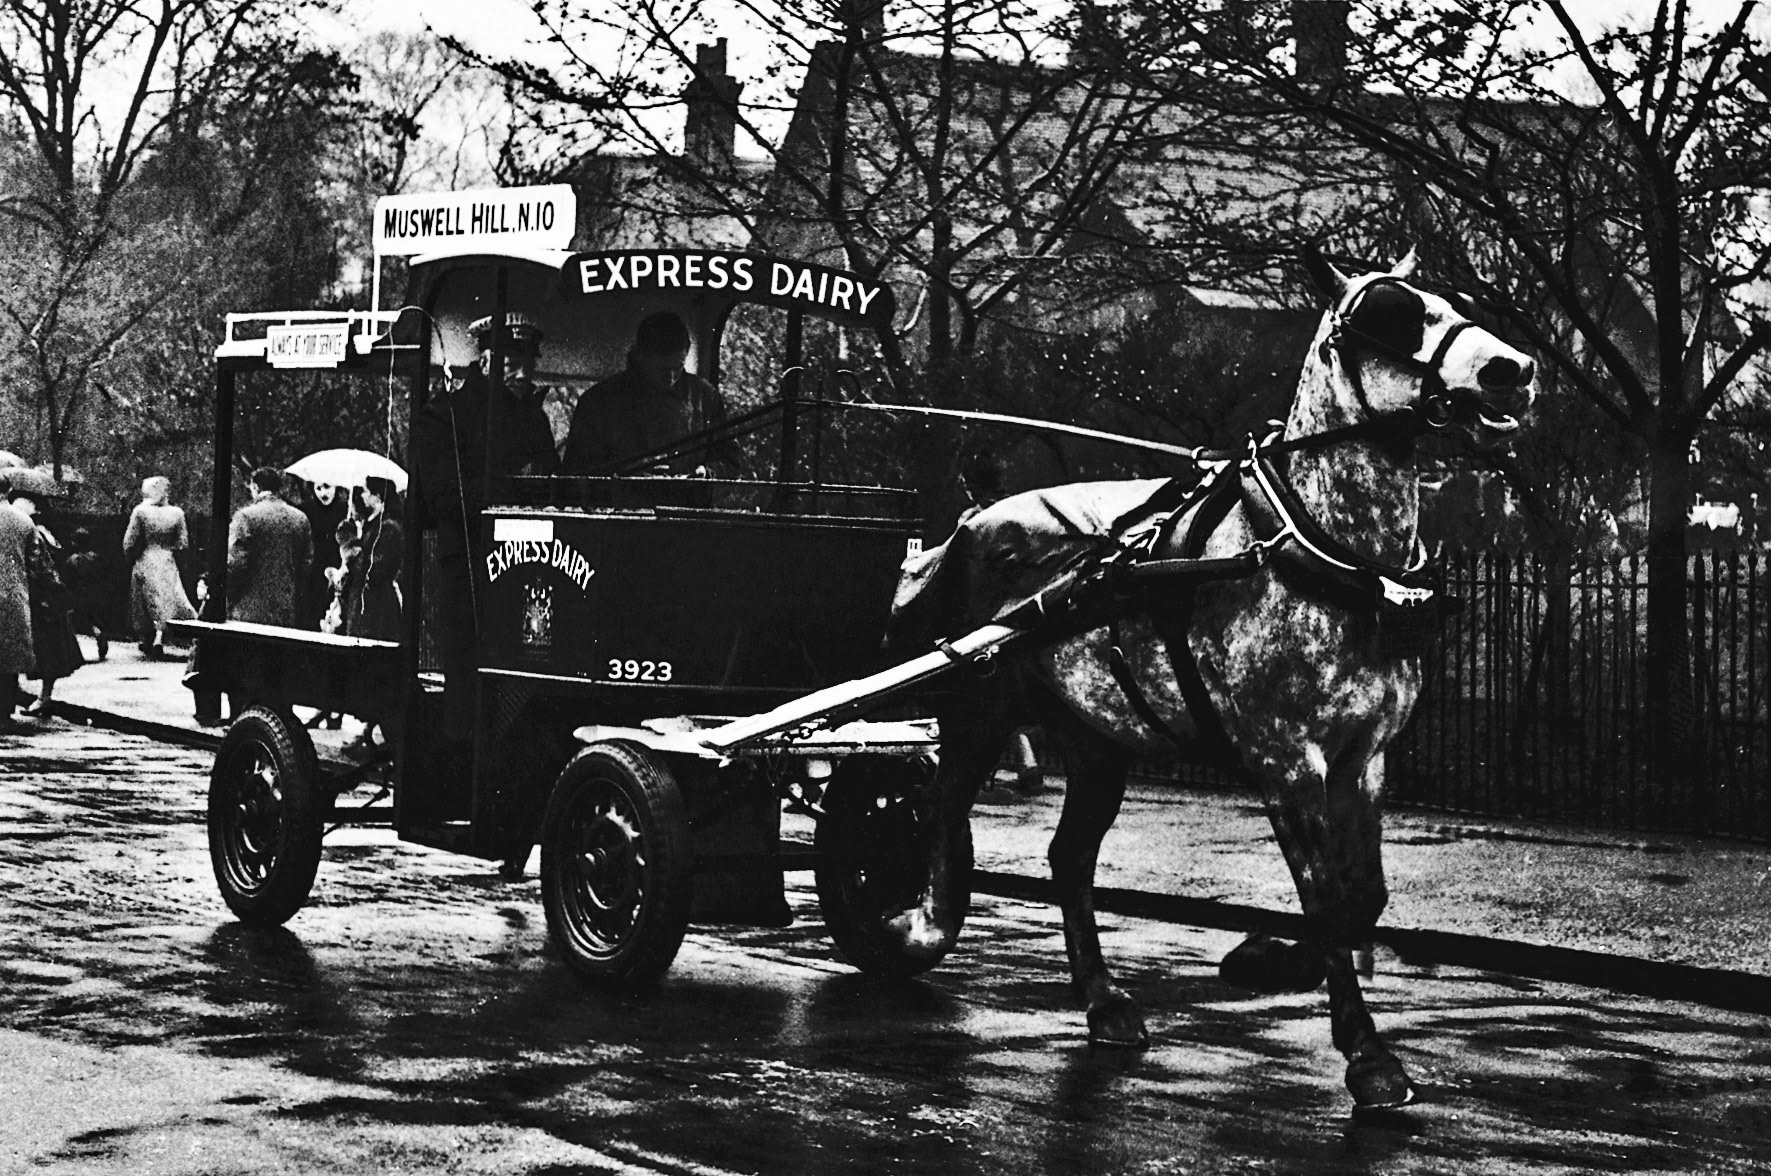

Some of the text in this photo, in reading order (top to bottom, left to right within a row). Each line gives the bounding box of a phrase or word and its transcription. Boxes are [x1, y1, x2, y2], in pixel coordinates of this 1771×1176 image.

[384, 206, 465, 239] MUSWELL
[580, 254, 881, 315] EXPRESS DAIRY
[486, 538, 595, 591] EXPRESS DAIRY
[608, 658, 672, 682] 3923
